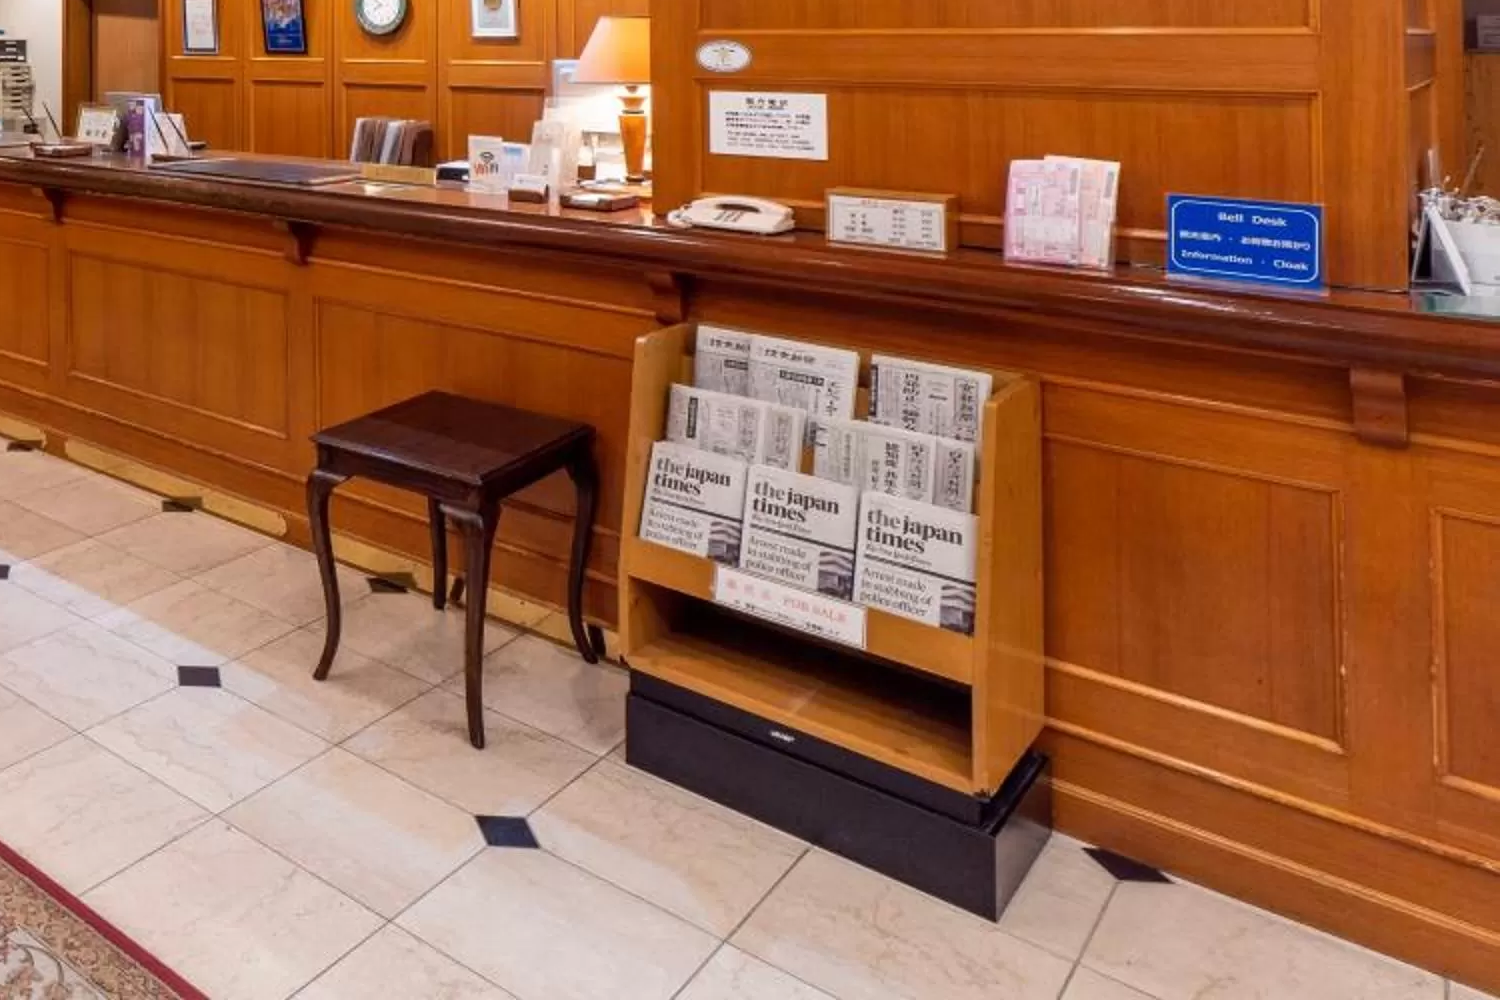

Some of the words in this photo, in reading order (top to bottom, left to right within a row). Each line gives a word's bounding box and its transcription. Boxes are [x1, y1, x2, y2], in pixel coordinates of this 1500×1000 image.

[1218, 212, 1245, 223] Bell
[1252, 215, 1287, 226] Desk
[1181, 250, 1253, 265] Information
[654, 472, 701, 495] times
[657, 457, 684, 475] the
[684, 462, 731, 487] japan
[753, 497, 806, 522] times
[754, 480, 785, 500] the
[787, 487, 839, 514] japan
[866, 526, 925, 553] times
[867, 509, 901, 529] the
[903, 515, 963, 546] japan
[863, 567, 894, 583] Arrest
[859, 590, 891, 606] police
[892, 599, 929, 617] officer
